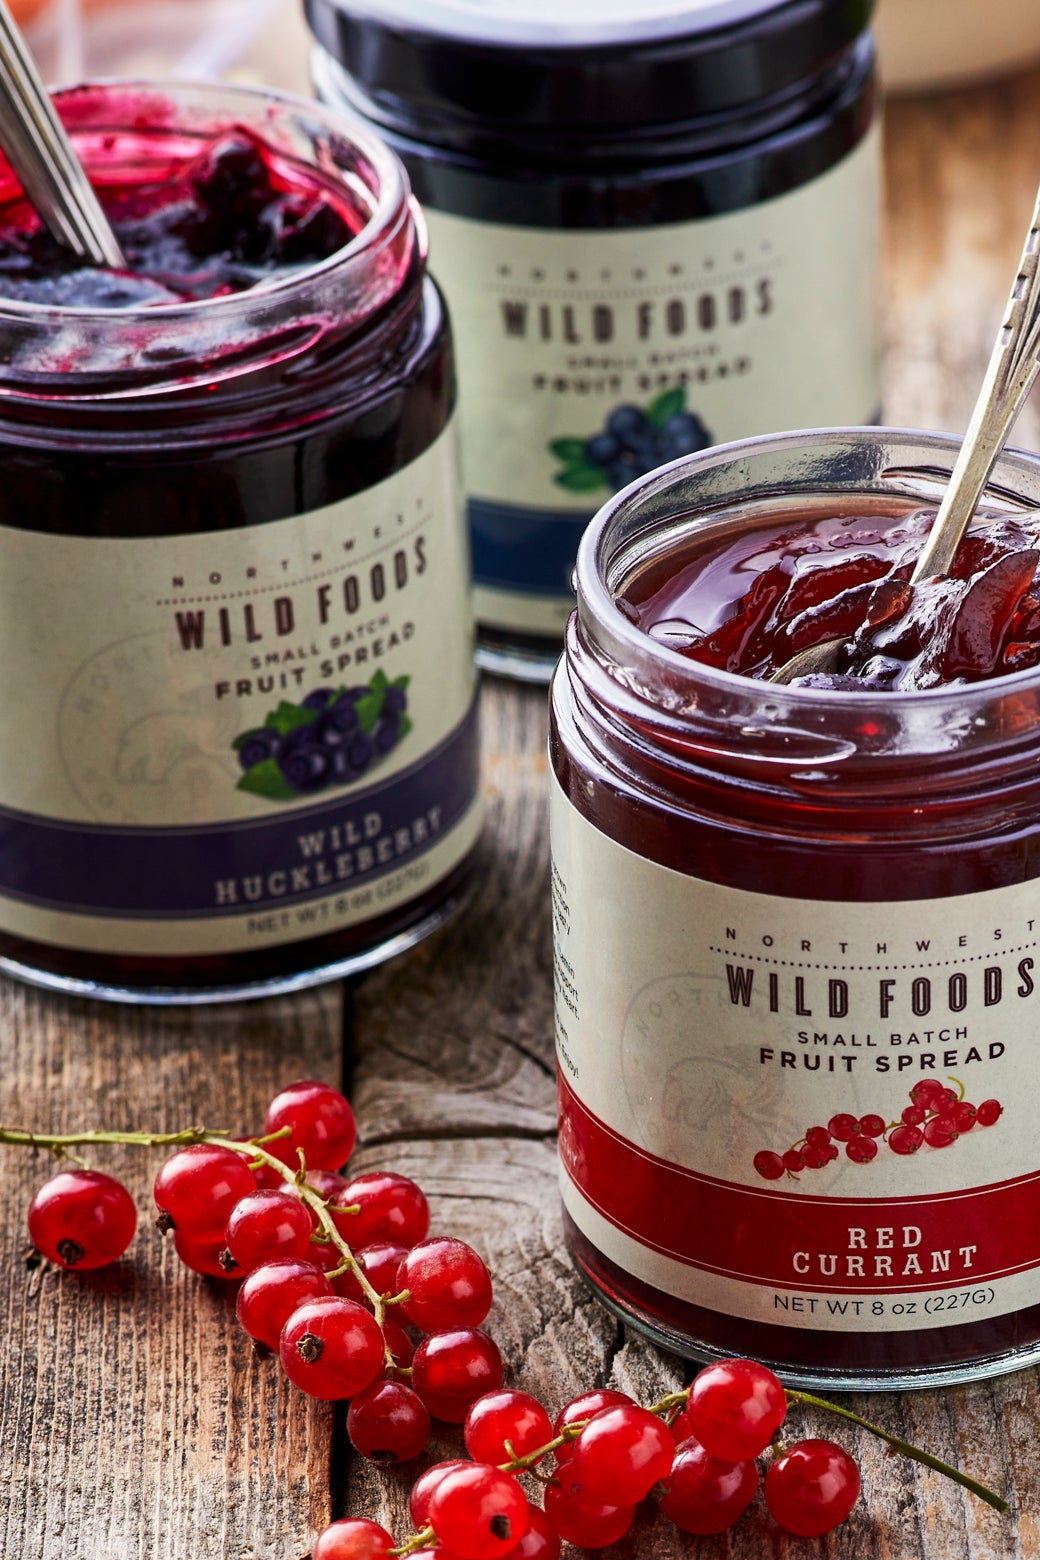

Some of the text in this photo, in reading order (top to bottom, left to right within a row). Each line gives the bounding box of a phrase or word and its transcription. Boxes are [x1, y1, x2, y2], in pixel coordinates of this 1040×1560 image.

[500, 278, 776, 345] WILD FOODS
[533, 357, 752, 393] FRUIT SPREAD
[171, 497, 428, 588] NORTHWEST
[175, 535, 429, 651] WILD FOODS
[215, 622, 417, 701] FRUIT SPREAD
[249, 614, 391, 671] SMALL BATCH
[298, 812, 383, 859] WILD
[214, 809, 444, 905] HUCKLEBERRY
[247, 911, 292, 935] NET
[297, 903, 331, 928] WT
[335, 897, 350, 918] 8
[725, 919, 1037, 954] NORTHWEST
[725, 964, 849, 1019] WILD
[879, 957, 1037, 1019] FOODS
[760, 1041, 1006, 1073] FRUIT SPREAD
[797, 1026, 969, 1047] SMALL BATCH
[847, 1225, 923, 1249] RED
[793, 1245, 978, 1278] CURRANT
[774, 1287, 996, 1316] NET WT 8 oz (227G)
